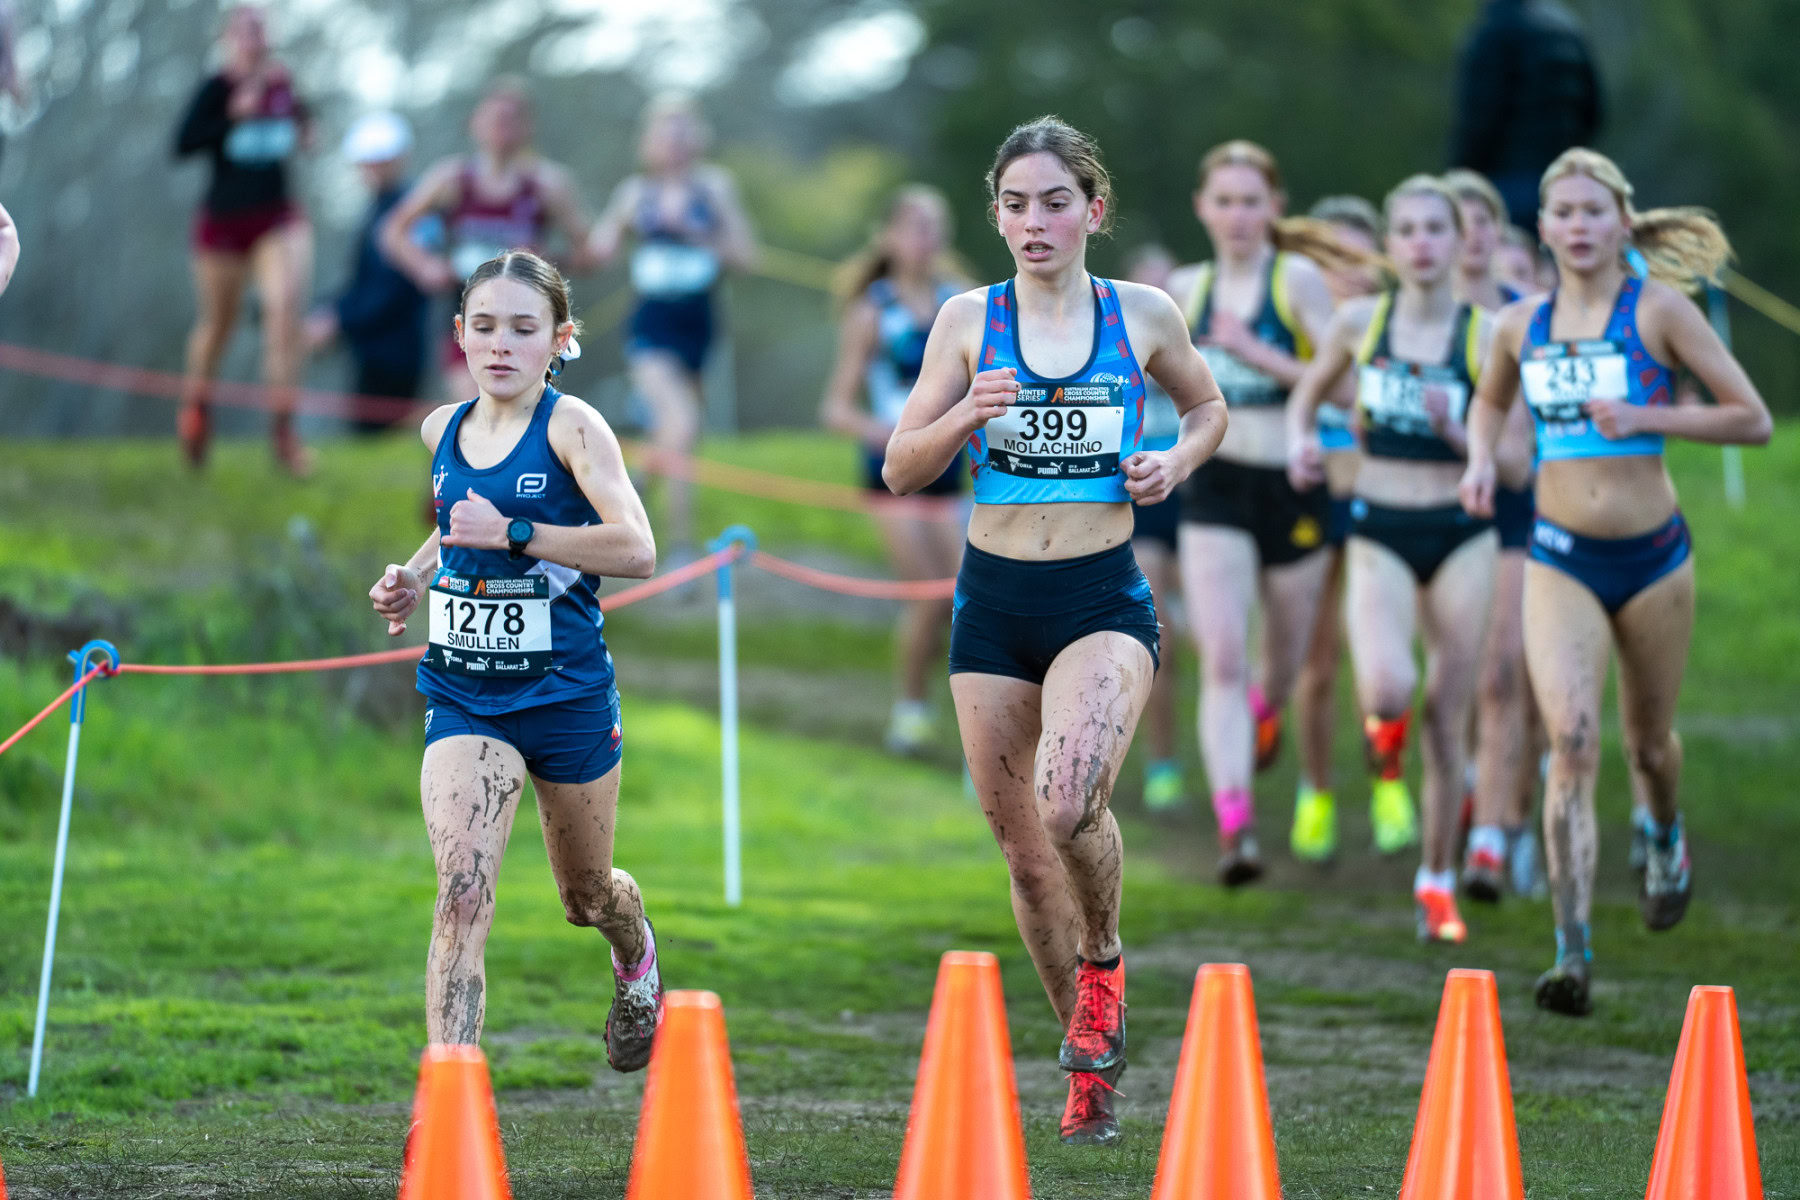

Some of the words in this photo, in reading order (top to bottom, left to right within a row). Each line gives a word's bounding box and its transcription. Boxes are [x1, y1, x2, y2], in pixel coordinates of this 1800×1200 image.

[1019, 409, 1087, 441] 399
[1003, 438, 1103, 455] MOLACHINO
[1037, 467, 1059, 475] PUMA
[445, 598, 525, 636] 1278
[447, 632, 520, 650] SMULLEN
[466, 662, 486, 671] PUMA
